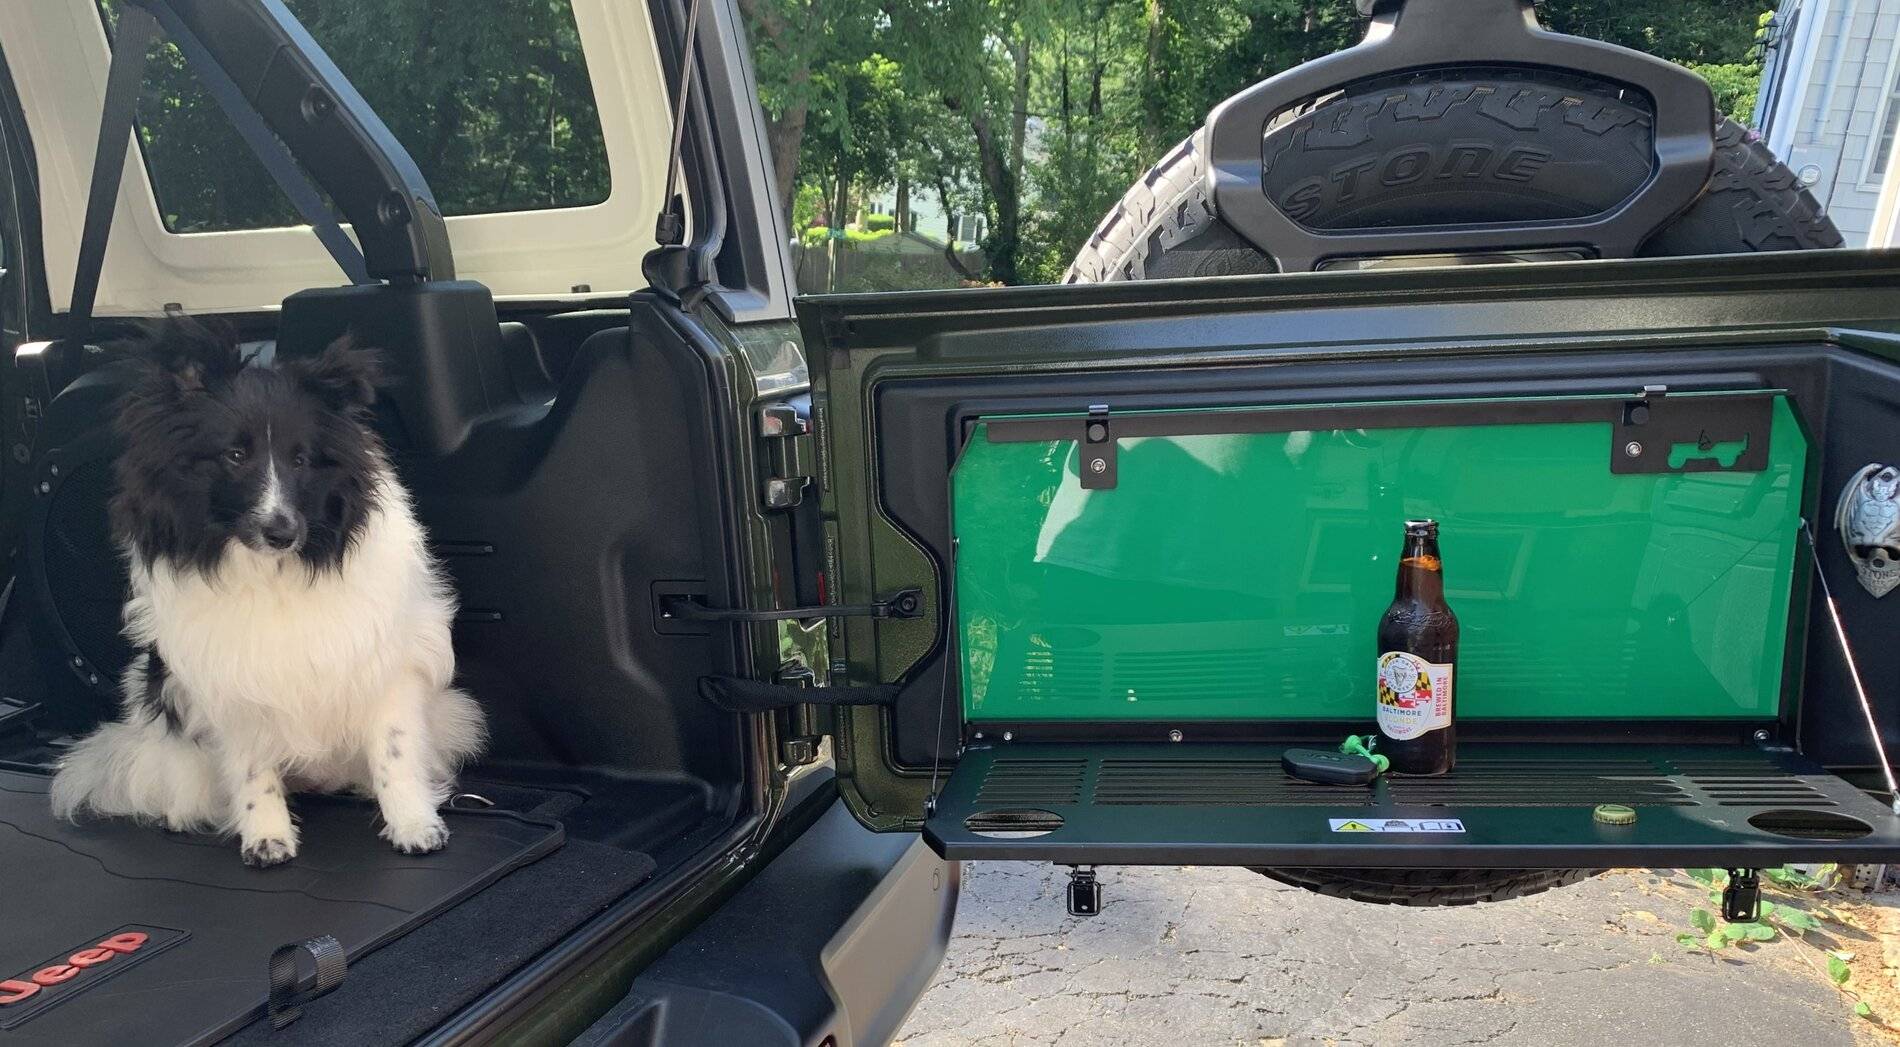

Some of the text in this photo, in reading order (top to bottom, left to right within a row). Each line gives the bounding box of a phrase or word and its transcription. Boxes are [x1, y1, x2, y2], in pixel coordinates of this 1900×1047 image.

[1436, 677, 1442, 687] IN
[1382, 706, 1422, 717] BALTIMORE
[0, 932, 149, 1005] Jeep
